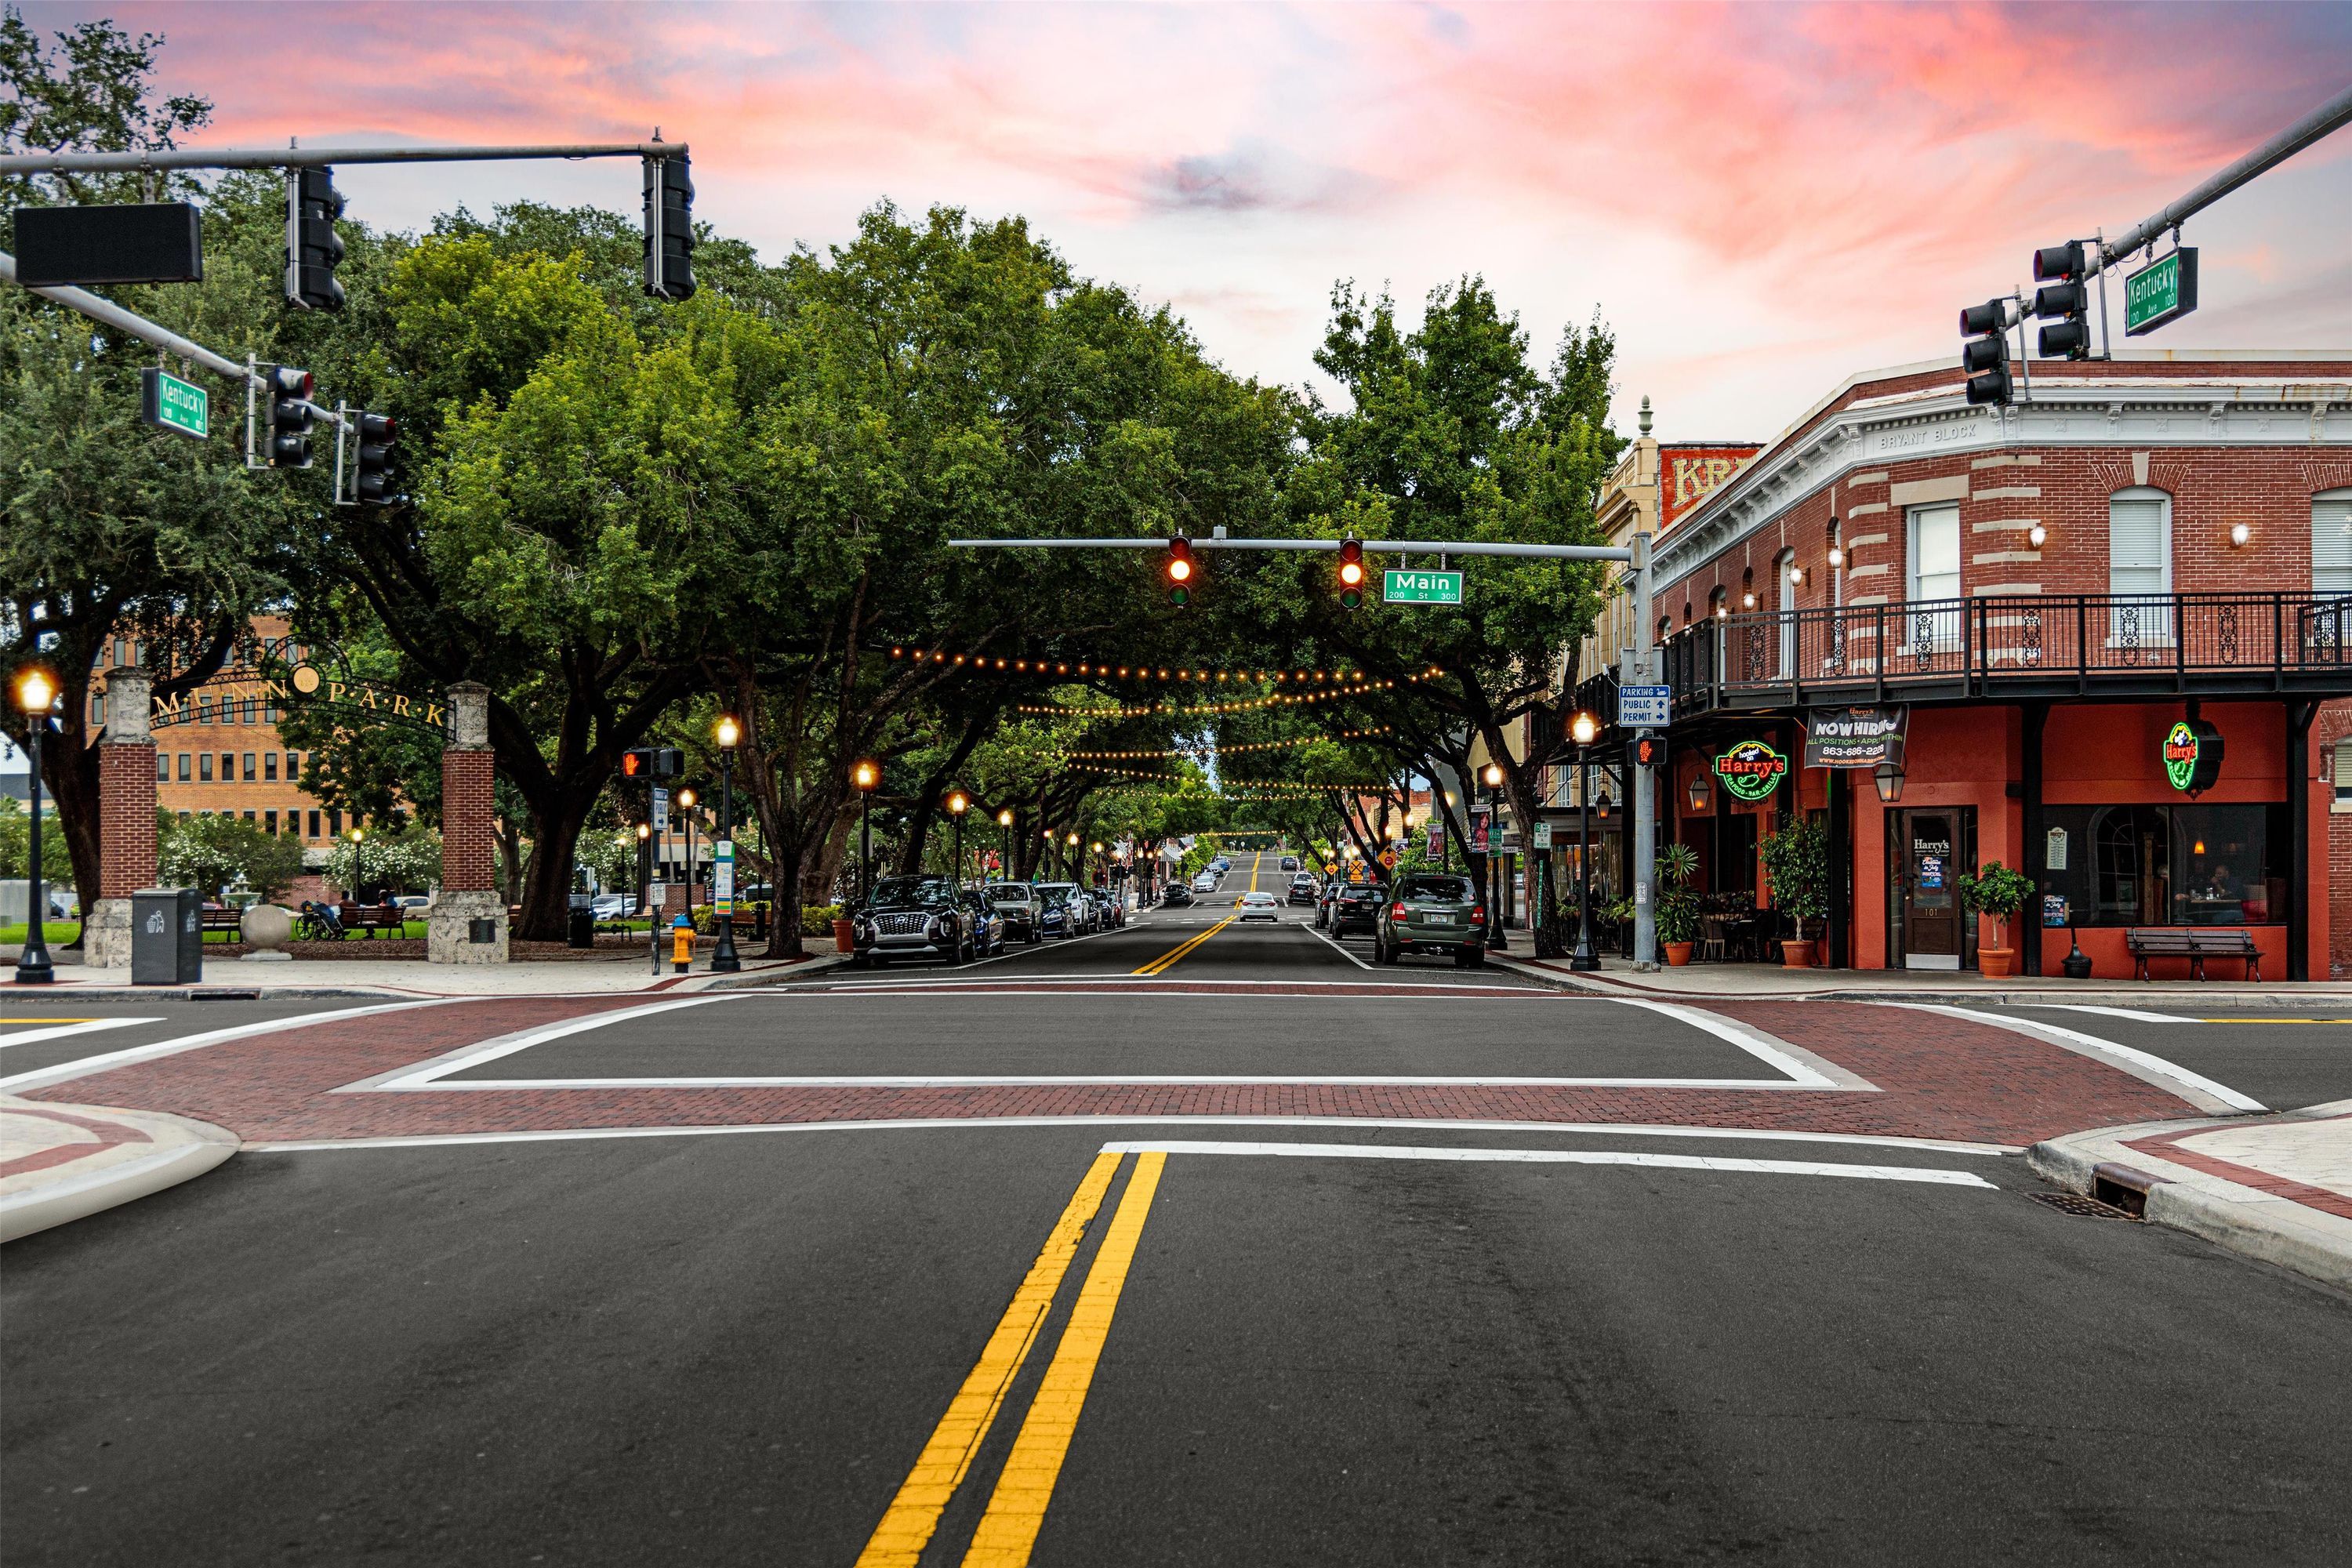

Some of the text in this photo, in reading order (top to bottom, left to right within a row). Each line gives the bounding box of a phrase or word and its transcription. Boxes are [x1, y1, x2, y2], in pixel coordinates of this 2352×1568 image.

[2130, 264, 2175, 307] Kentucky
[2147, 304, 2158, 315] Ave
[2165, 292, 2175, 307] 100
[162, 377, 204, 421] Kentucky
[163, 407, 172, 419] 100
[1880, 423, 1976, 450] BRYANT BLOCK
[1396, 573, 1450, 590] Main
[1622, 688, 1653, 697] PARKING
[1624, 699, 1650, 709] PUBLIC
[1624, 712, 1652, 721] PERMIT
[1815, 722, 1853, 736] NOW
[1881, 733, 1903, 742] WITHIN
[1739, 747, 1759, 759] hooked
[1822, 744, 1885, 756] 863-686-2228
[2166, 742, 2197, 764] Harry's
[1719, 758, 1784, 778] Harry's
[1914, 839, 1950, 854] Harry's
